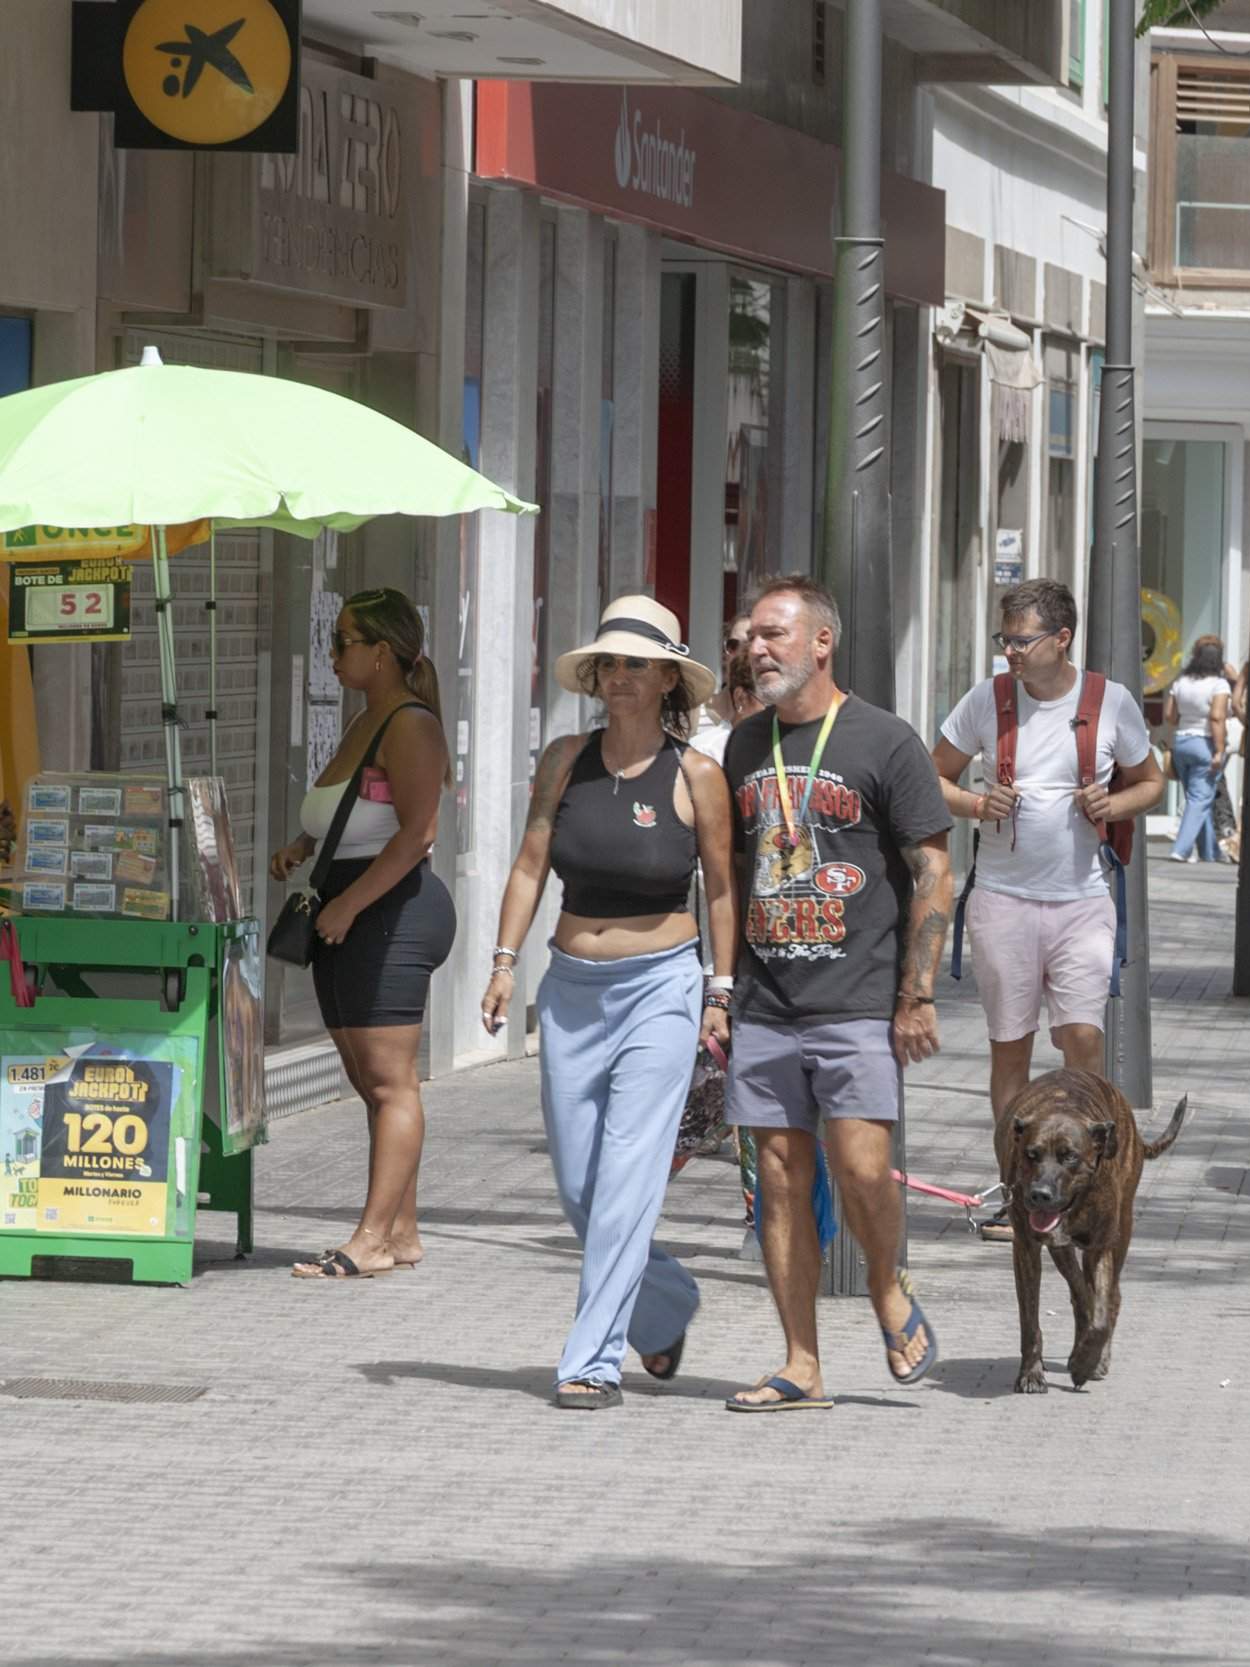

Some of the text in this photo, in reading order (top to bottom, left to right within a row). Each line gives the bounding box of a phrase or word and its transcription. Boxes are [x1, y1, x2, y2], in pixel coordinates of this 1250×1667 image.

[632, 109, 696, 209] Santander
[15, 574, 63, 586] BOTE DE
[10, 1067, 46, 1081] 1.481
[68, 1081, 142, 1100] JACKPOT
[63, 1112, 149, 1156] 120
[63, 1155, 145, 1170] MILLONES
[63, 1186, 142, 1199] MILLONARIO
